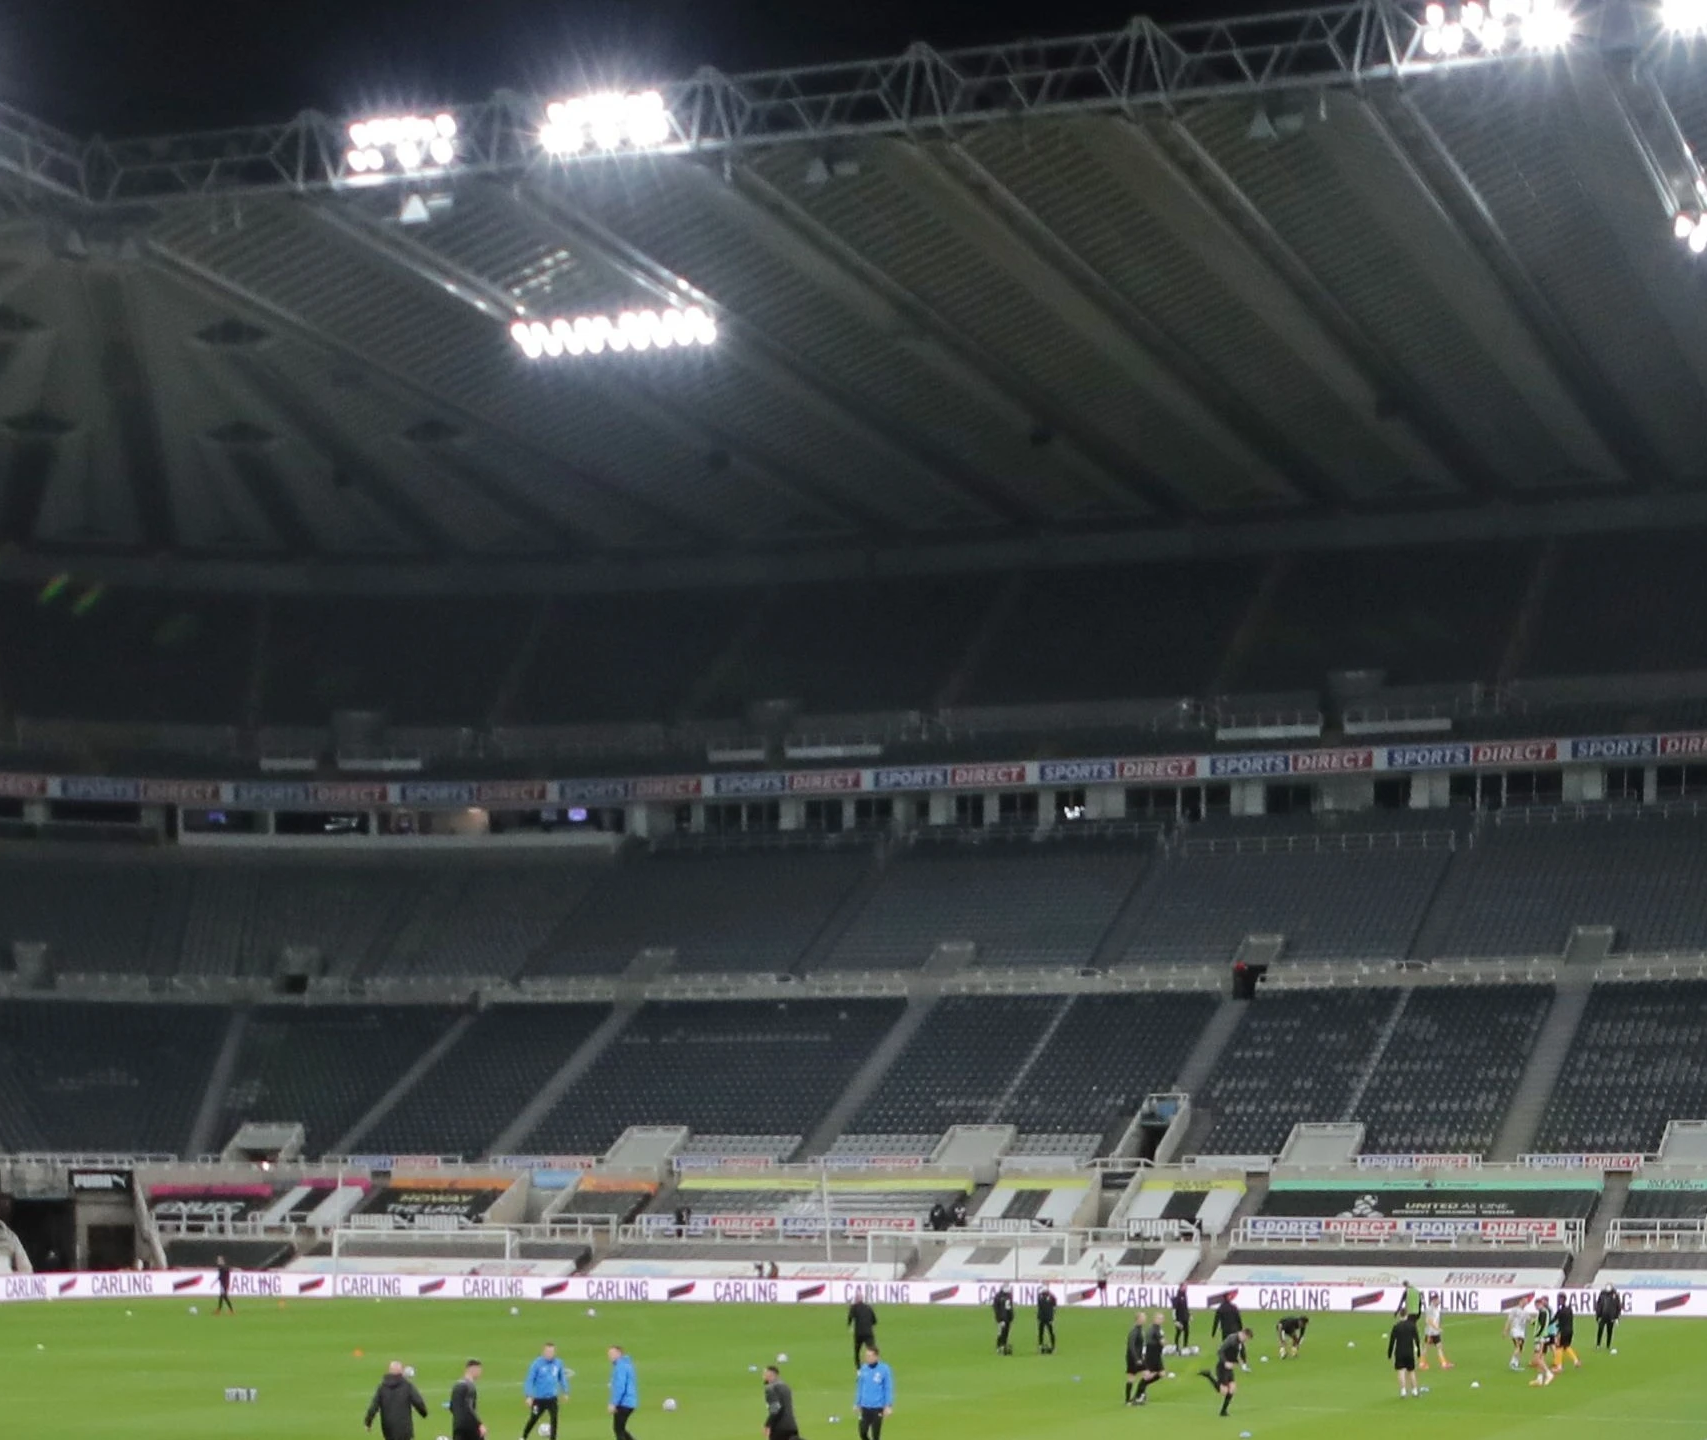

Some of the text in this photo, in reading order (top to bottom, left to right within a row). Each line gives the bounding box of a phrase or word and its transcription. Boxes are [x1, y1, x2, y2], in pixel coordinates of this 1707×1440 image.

[1392, 742, 1550, 765] SPORTS DIRECT
[1576, 738, 1653, 757] SPORTS
[1043, 759, 1192, 780] SPORTS DIRECT
[1214, 751, 1368, 775] SPORTS DIRECT
[877, 764, 1019, 787] SPORTS DIRECT
[1532, 1156, 1639, 1168] SPORTS DIRECT
[1255, 1220, 1392, 1235] SPORTS DIRECT
[1410, 1220, 1553, 1236] SPORTS DIRECT
[6, 1277, 47, 1298] CARLING
[91, 1274, 152, 1294] CARLING
[231, 1275, 281, 1294] ARLING
[342, 1277, 401, 1295] CARLING
[462, 1278, 524, 1297] CARLING
[586, 1280, 649, 1300] CARLING
[713, 1282, 778, 1302] CARLING
[1116, 1287, 1179, 1308] CARLIN
[1258, 1289, 1330, 1310] CARLING
